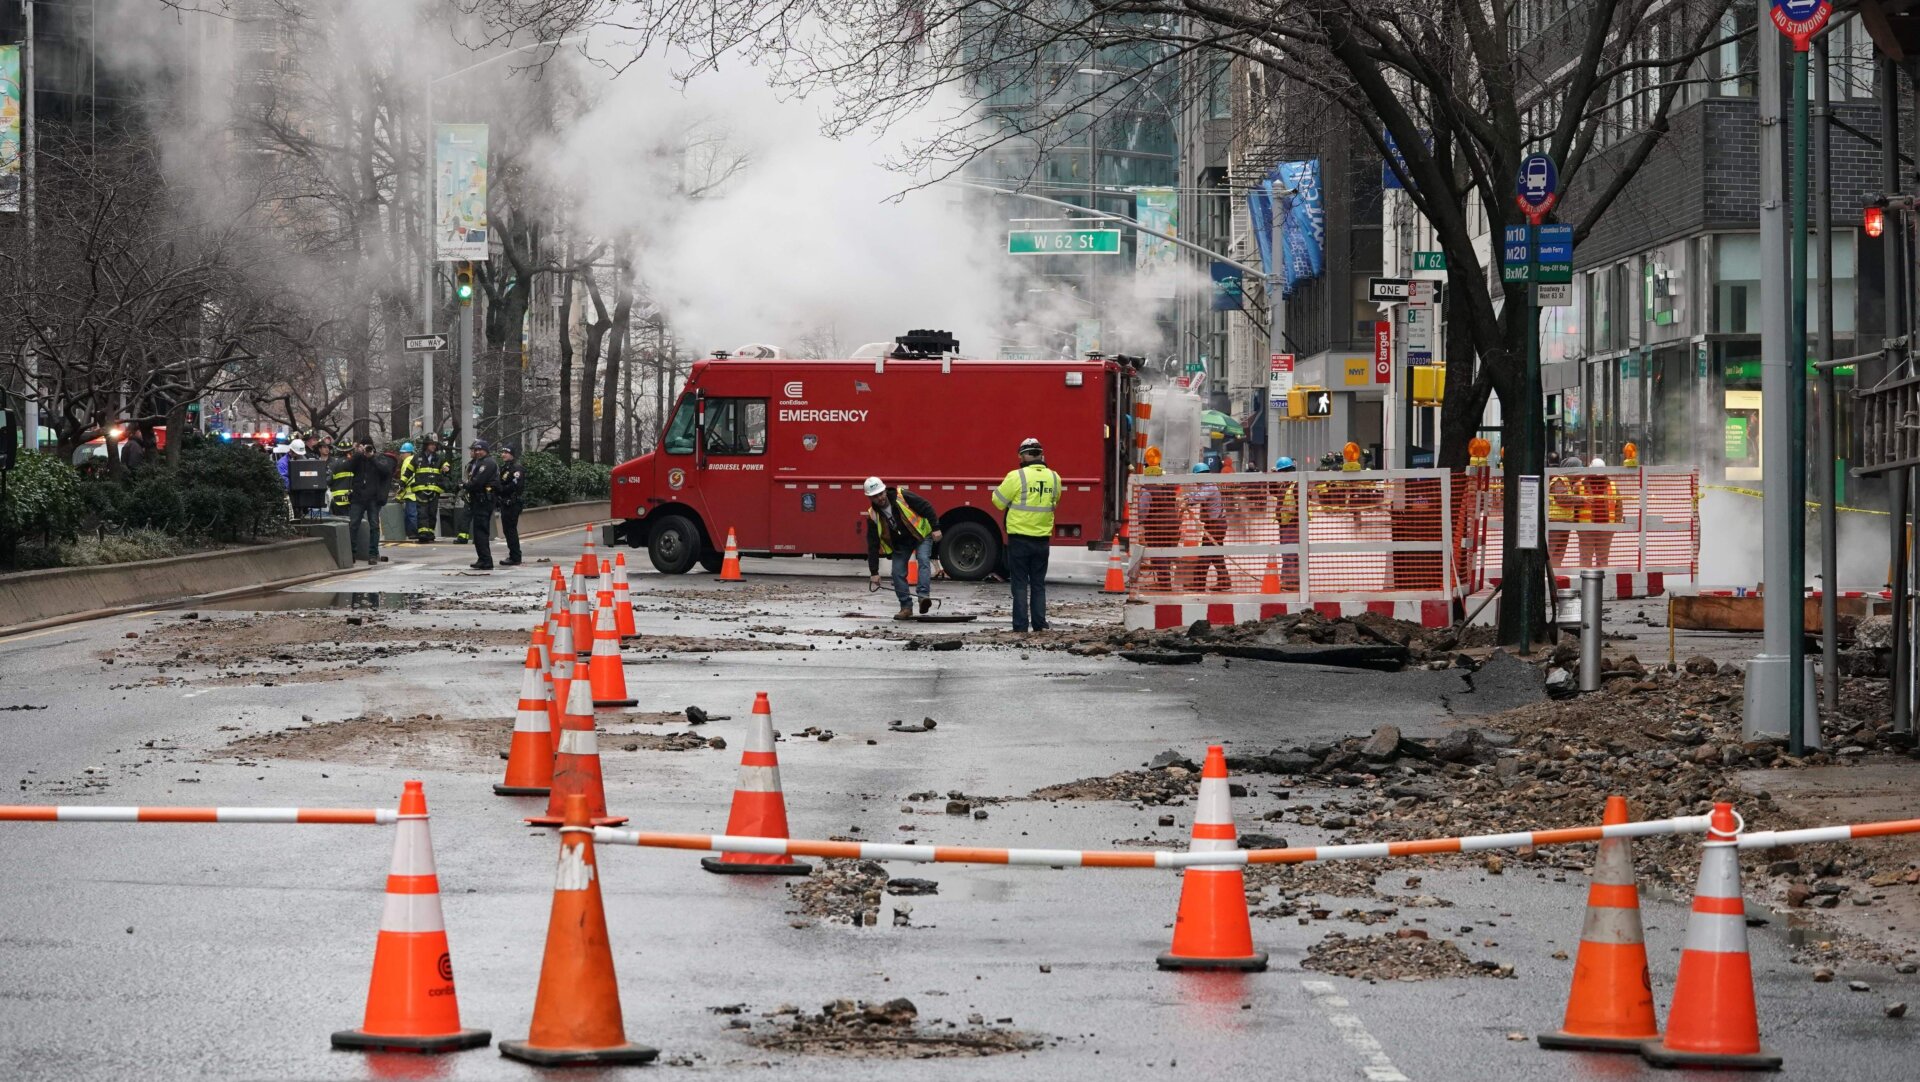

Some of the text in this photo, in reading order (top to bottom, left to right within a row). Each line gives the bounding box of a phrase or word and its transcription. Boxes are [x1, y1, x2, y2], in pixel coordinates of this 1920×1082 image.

[1774, 6, 1827, 34] NO STANDING
[1519, 196, 1553, 214] NO STANDING
[1034, 234, 1094, 249] W 62 St
[1506, 228, 1526, 242] M10
[1506, 246, 1527, 260] M20
[1418, 254, 1442, 268] W 62
[1540, 264, 1570, 272] Drop-Off Only
[1505, 265, 1529, 279] BxM2
[1379, 285, 1400, 295] ONE
[1378, 331, 1389, 361] target
[779, 409, 869, 422] EMERGENCY
[708, 463, 764, 471] BIODIESEL POWER
